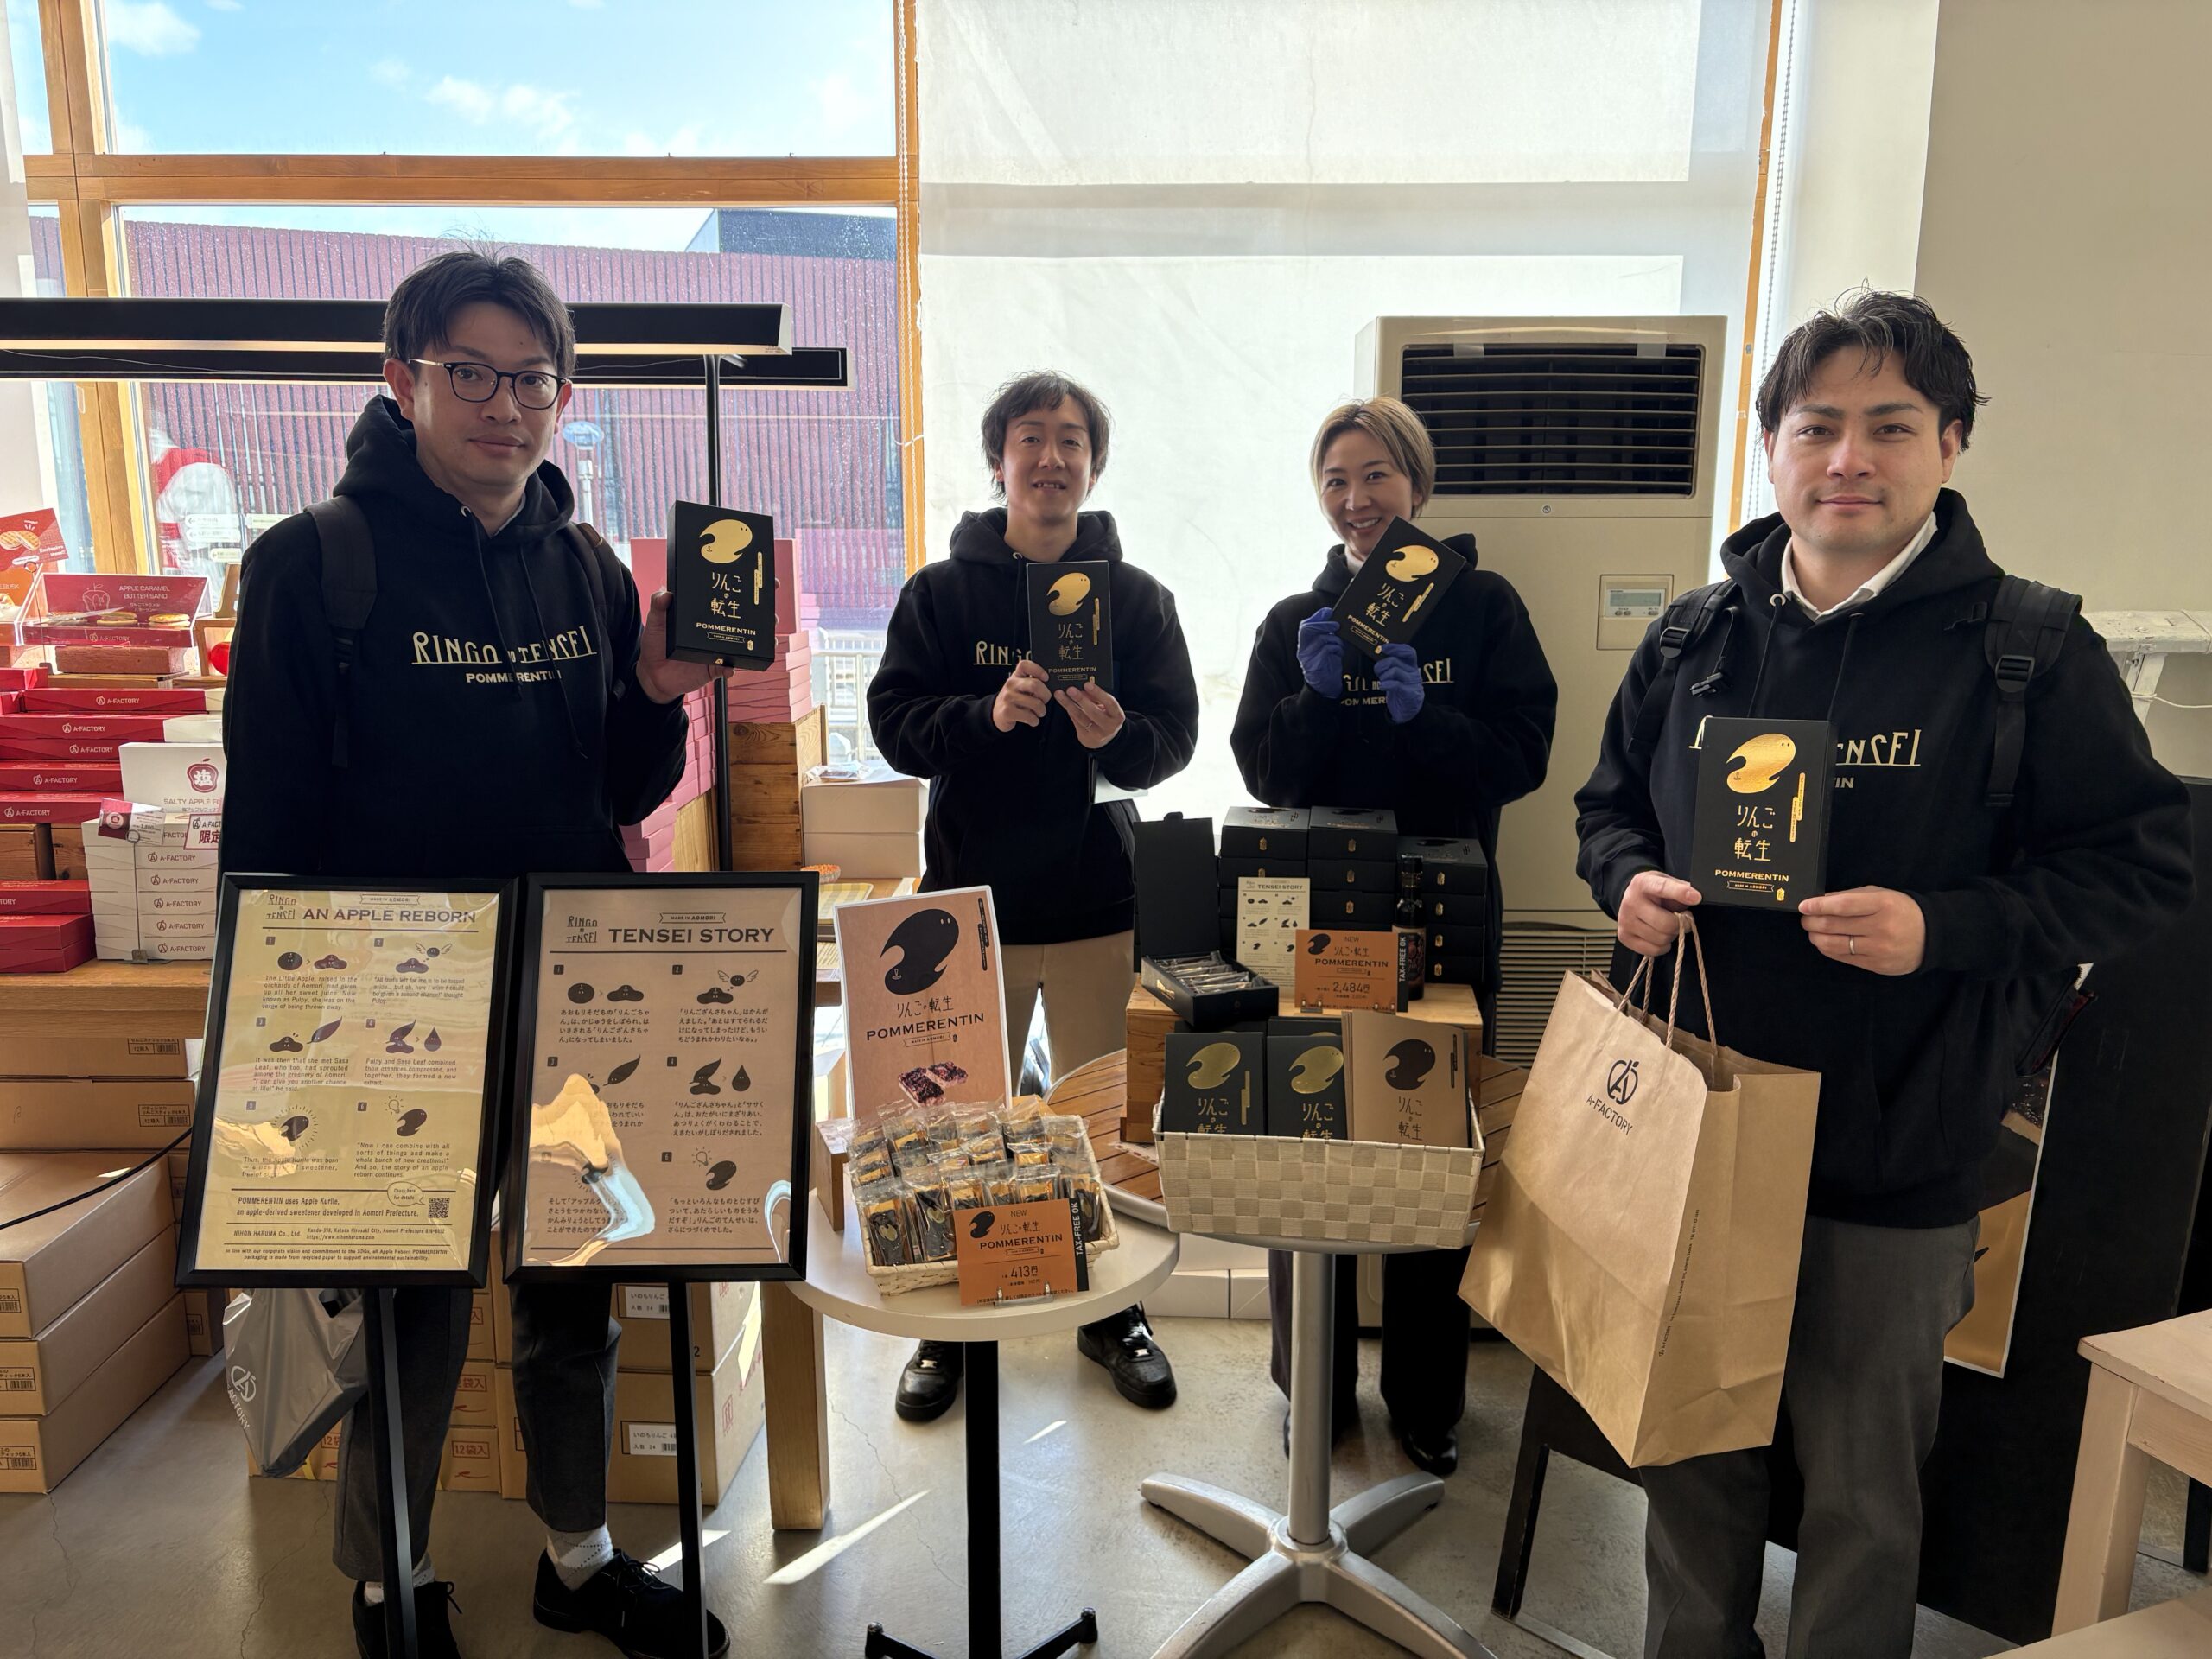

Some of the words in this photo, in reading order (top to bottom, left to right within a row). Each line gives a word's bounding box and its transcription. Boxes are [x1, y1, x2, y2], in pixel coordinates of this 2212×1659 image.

[712, 571, 742, 593] りんご
[1377, 582, 1405, 607] りんご
[711, 597, 741, 619] 転生
[1366, 602, 1391, 627] 転生
[696, 622, 756, 636] POMMERENTIN
[1058, 623, 1084, 639] りんご
[1347, 615, 1390, 644] POMMERENTIN
[1058, 645, 1084, 661] 転生
[1836, 729, 1922, 767] NSEI
[1736, 805, 1776, 829] りんご
[1734, 837, 1771, 862] 転生
[1715, 869, 1789, 882] POMMERENTIN
[303, 909, 329, 920] AN
[334, 909, 394, 922] APPLE
[399, 910, 476, 923] REBORN
[608, 928, 692, 943] TENSEI
[699, 928, 775, 943] STORY
[1400, 936, 1406, 946] OK
[1315, 958, 1389, 967] POMMERENTIN
[866, 1013, 985, 1041] POMMERENTIN
[1198, 1097, 1229, 1116] りんご
[1303, 1102, 1334, 1122] りんご
[1398, 1096, 1424, 1116] りんご
[1586, 1094, 1633, 1135] A-FACTORY
[1398, 1121, 1424, 1141] 転生
[1071, 1202, 1078, 1213] OK
[980, 1233, 1063, 1250] POMMERENTIN
[1072, 1216, 1084, 1256] TAX-FREE
[228, 1387, 250, 1430] ACTORY
[454, 1444, 488, 1455] 12袋入
